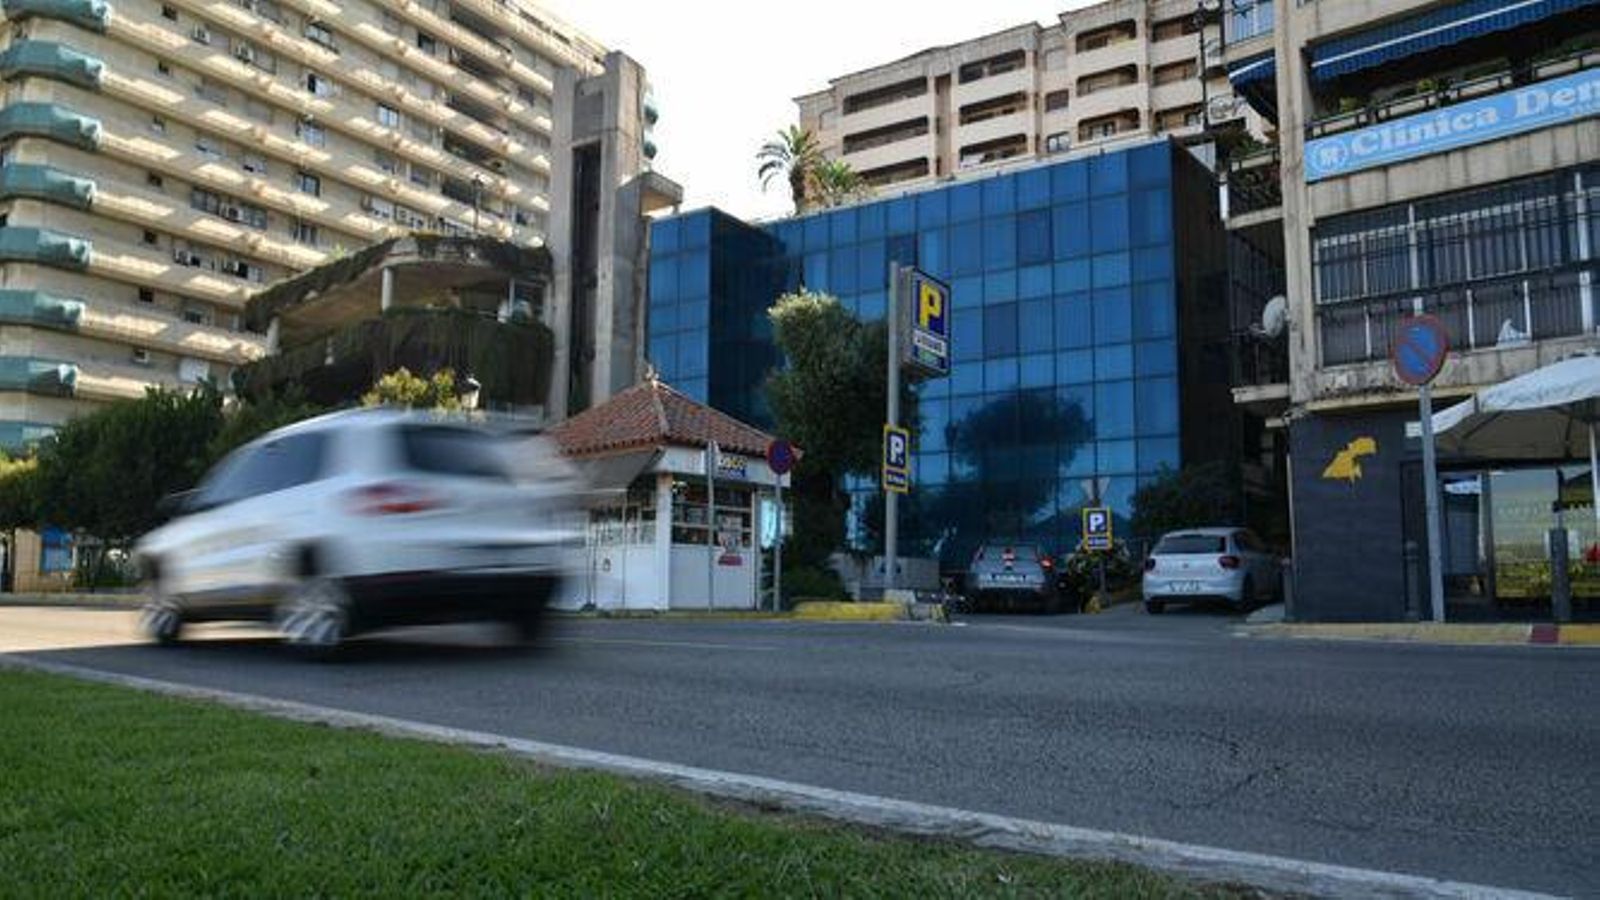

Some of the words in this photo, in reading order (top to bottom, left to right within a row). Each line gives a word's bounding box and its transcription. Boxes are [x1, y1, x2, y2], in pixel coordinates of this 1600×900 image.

[920, 283, 942, 329] P
[890, 434, 904, 463] P
[1089, 512, 1105, 532] P
